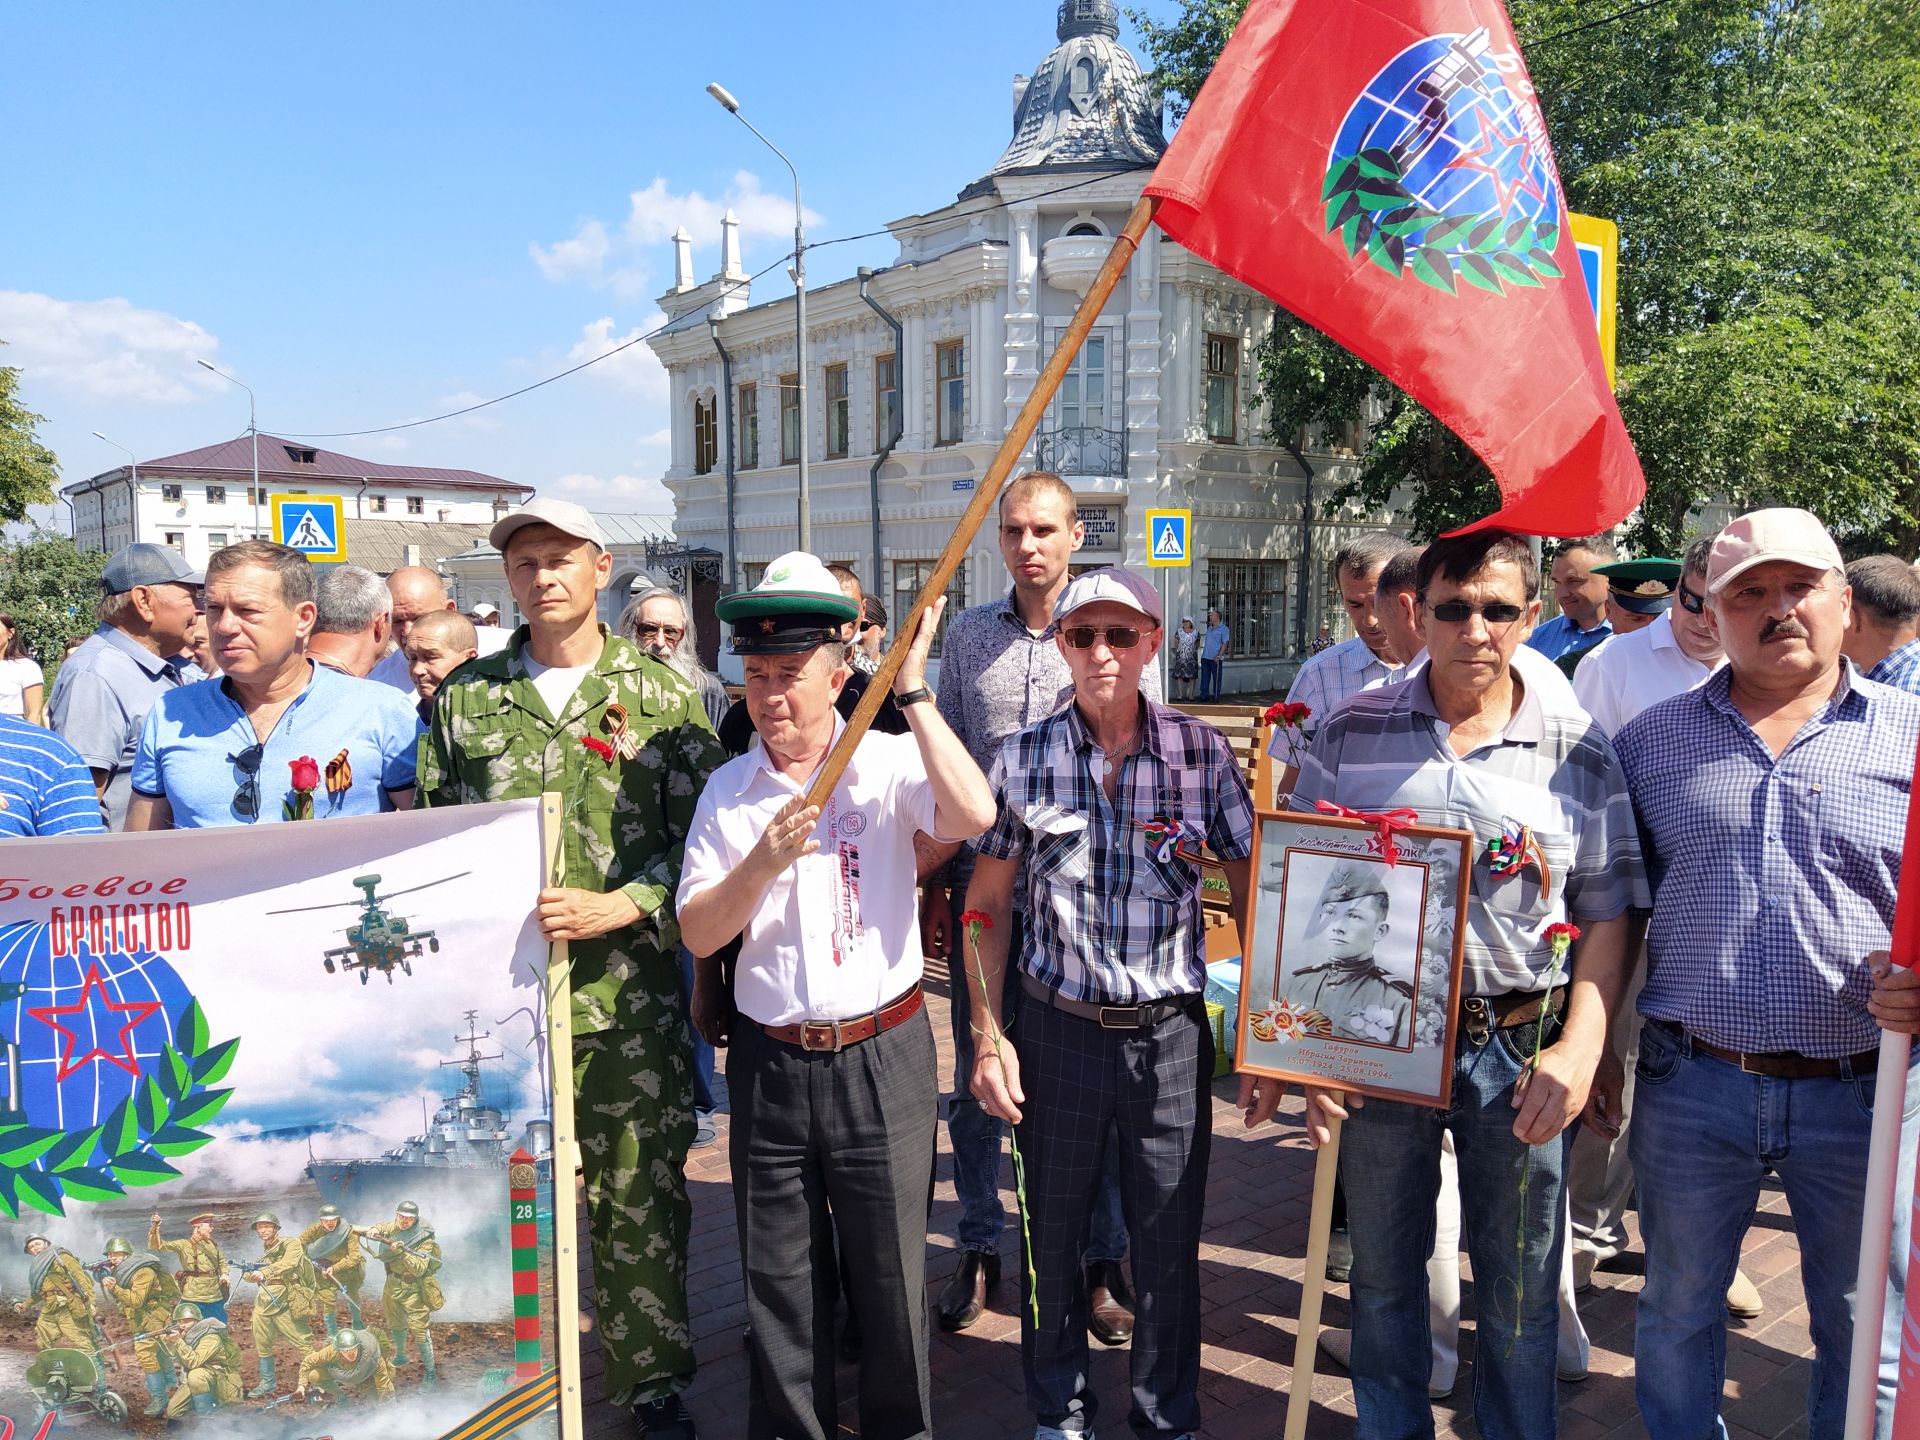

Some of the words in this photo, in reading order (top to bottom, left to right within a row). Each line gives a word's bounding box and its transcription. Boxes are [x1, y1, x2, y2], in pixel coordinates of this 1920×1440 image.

[1077, 507, 1107, 520] ЕЙНЫЙ
[1084, 520, 1115, 533] РНЫЙ
[1083, 534, 1103, 546] ОНЪ
[1396, 847, 1418, 858] ОЛК
[51, 901, 191, 956] БРАТСТВО
[1323, 1042, 1360, 1055] Гафуров
[1297, 1048, 1336, 1061] Ибрагим
[1337, 1054, 1384, 1068] Зарипович
[1327, 1072, 1367, 1084] сержант
[516, 1204, 533, 1219] 28
